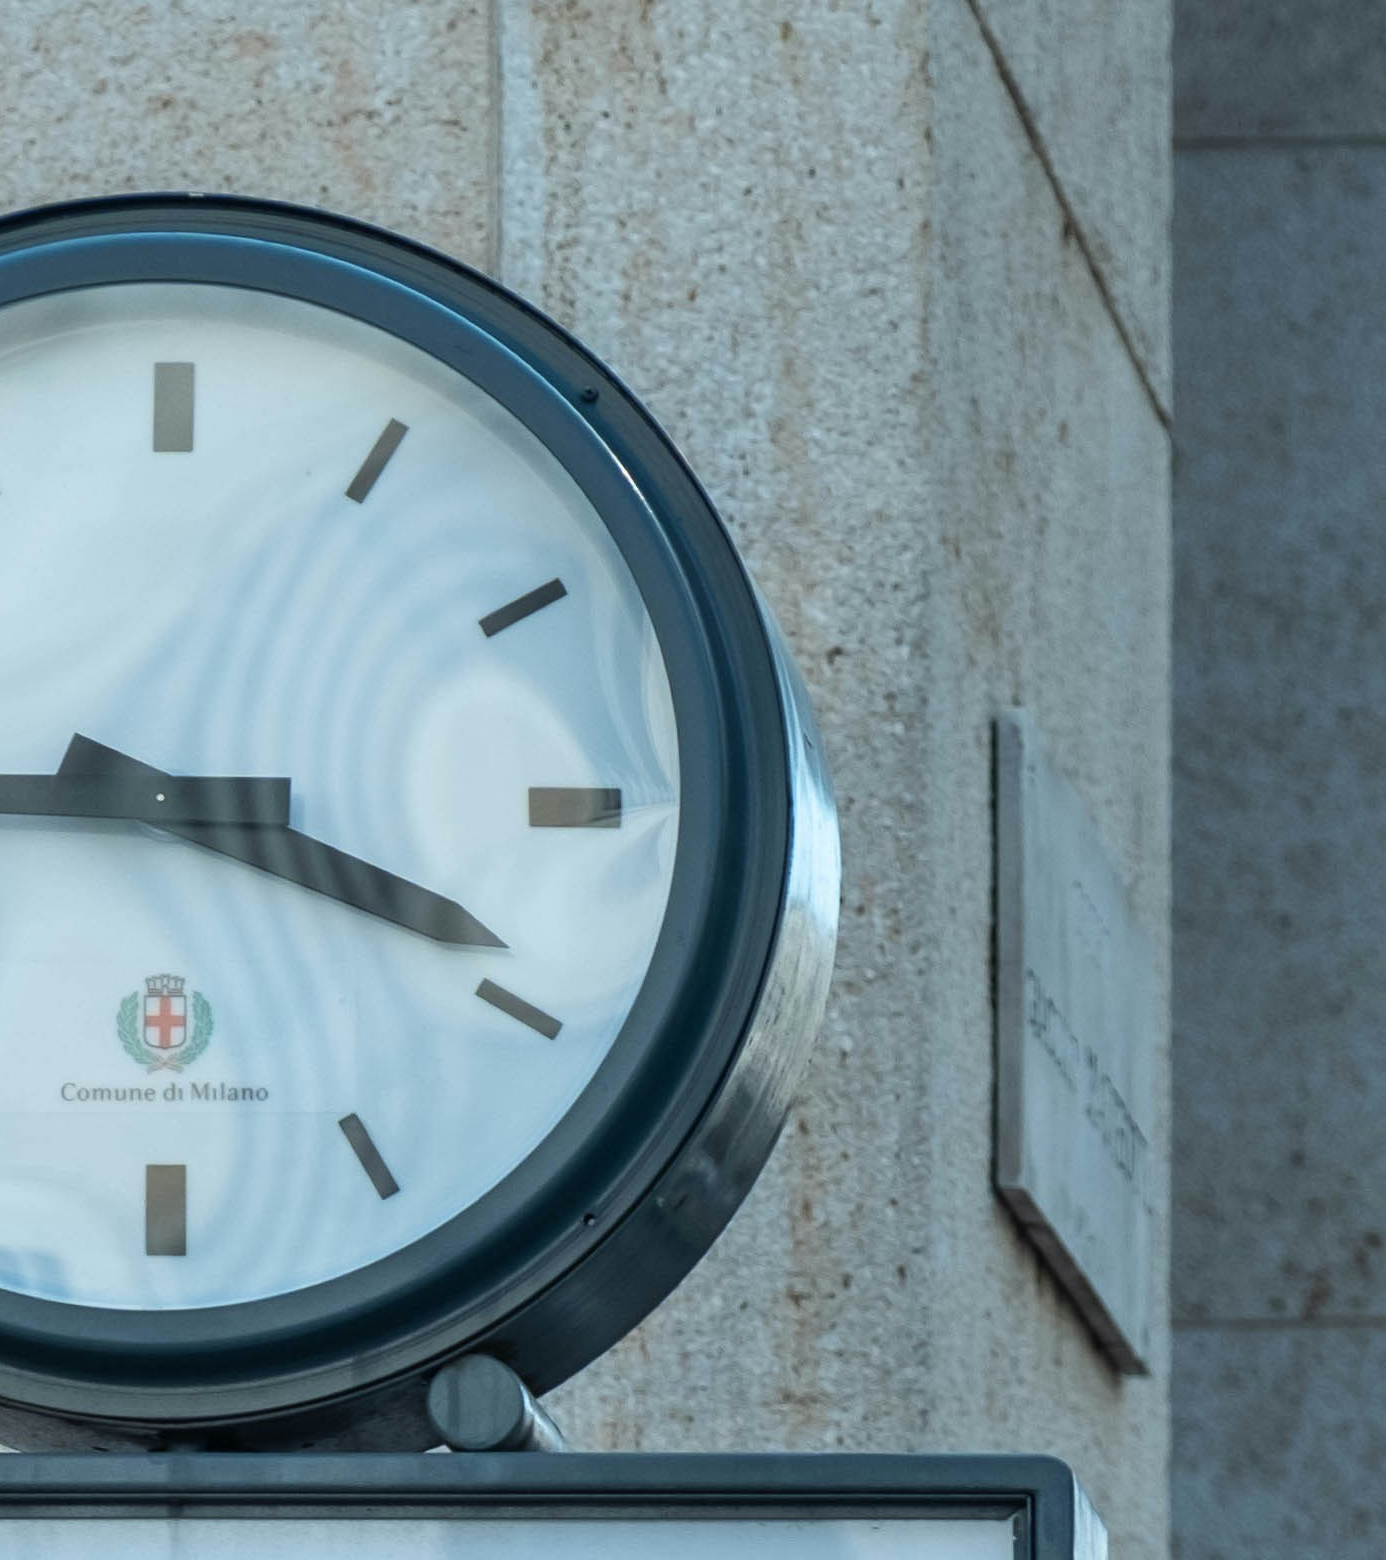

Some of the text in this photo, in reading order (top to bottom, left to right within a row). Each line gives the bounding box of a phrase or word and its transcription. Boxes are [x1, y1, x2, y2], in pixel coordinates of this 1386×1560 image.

[60, 1081, 270, 1103] Comune di Milano
